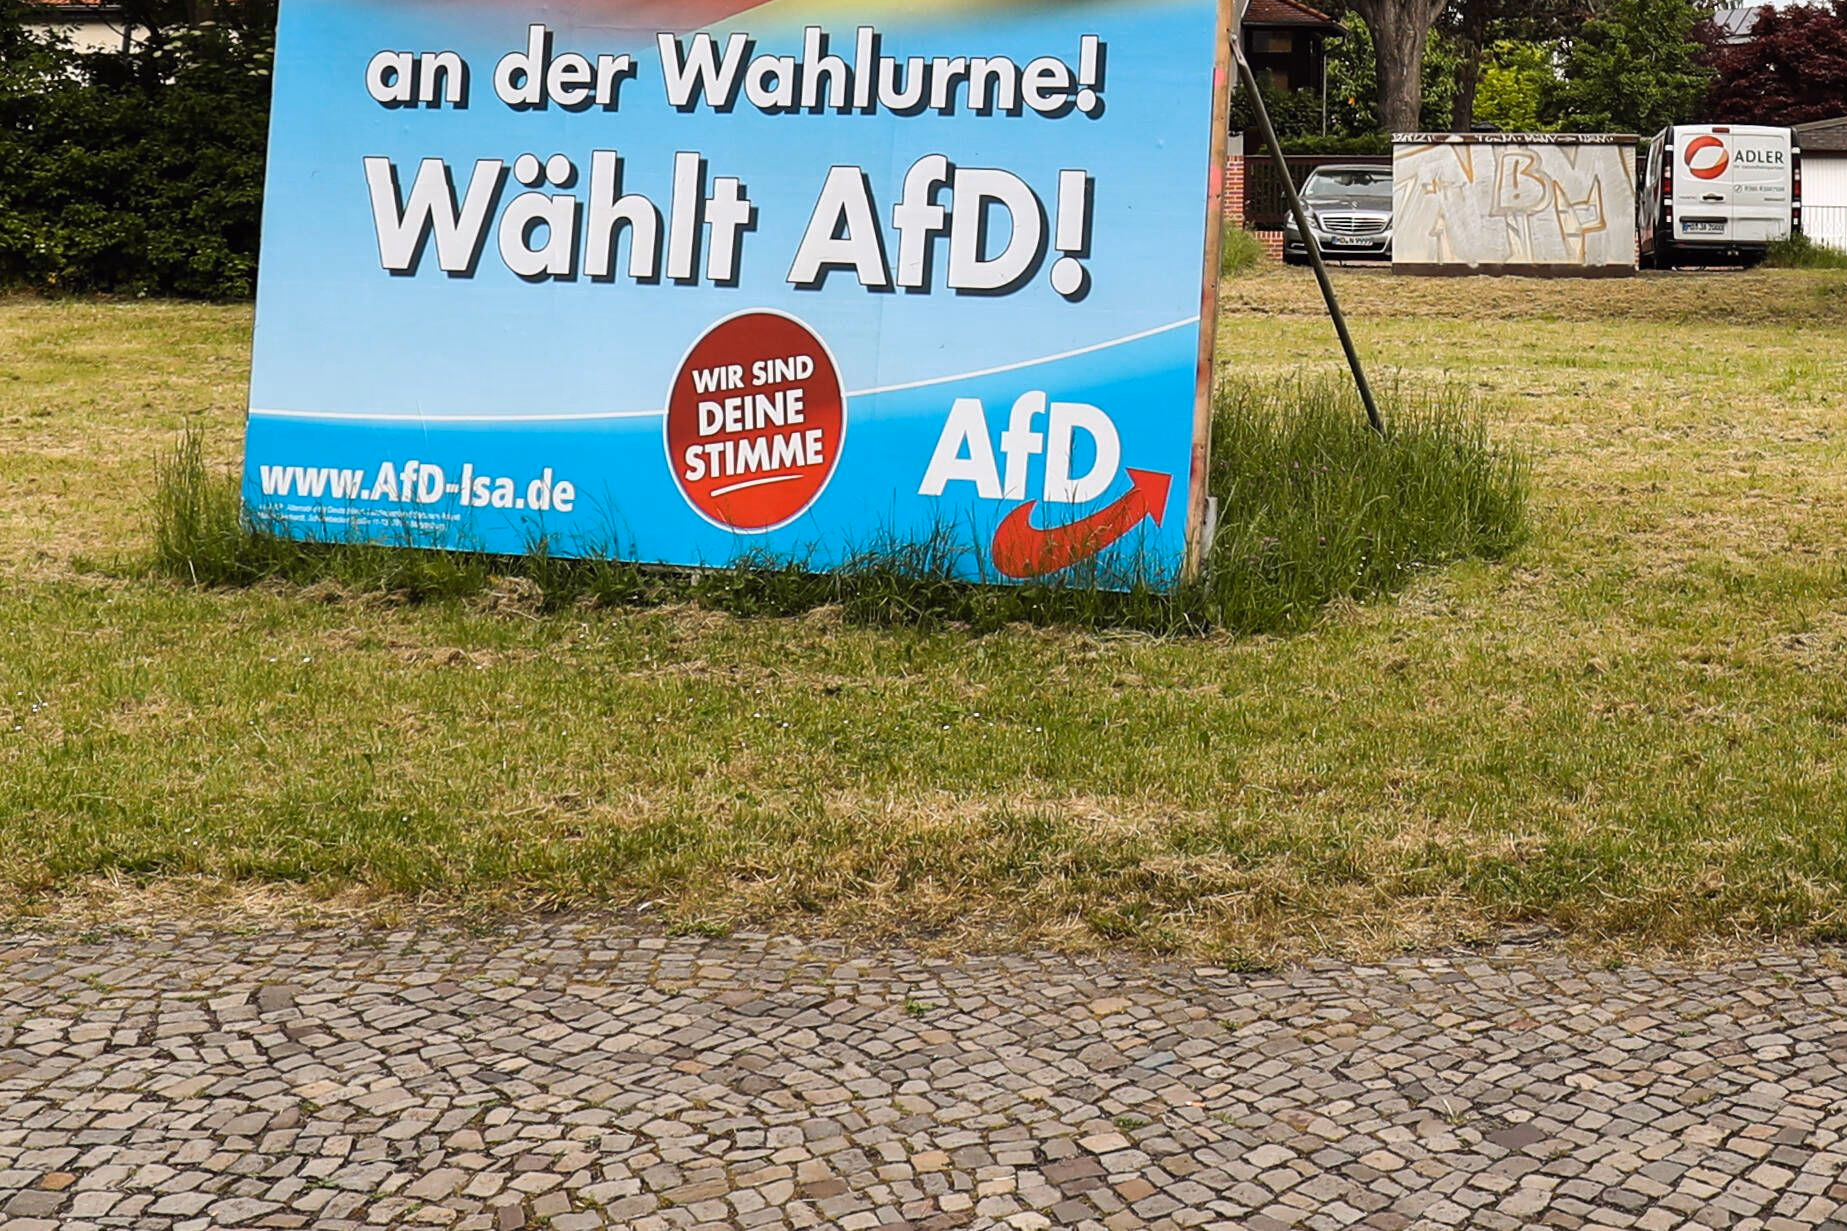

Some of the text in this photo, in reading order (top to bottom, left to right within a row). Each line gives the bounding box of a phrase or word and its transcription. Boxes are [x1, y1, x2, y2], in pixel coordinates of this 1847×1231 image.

[365, 24, 1103, 114] an der Wahlurne!
[1734, 149, 1785, 164] ADLER
[363, 150, 1090, 297] Wählt AfD!
[692, 355, 815, 394] WIR SIND
[697, 388, 805, 437] DEINE
[683, 428, 825, 482] STIMME
[917, 390, 1122, 503] AfD
[259, 460, 577, 513] www.AfD-lsa.de
